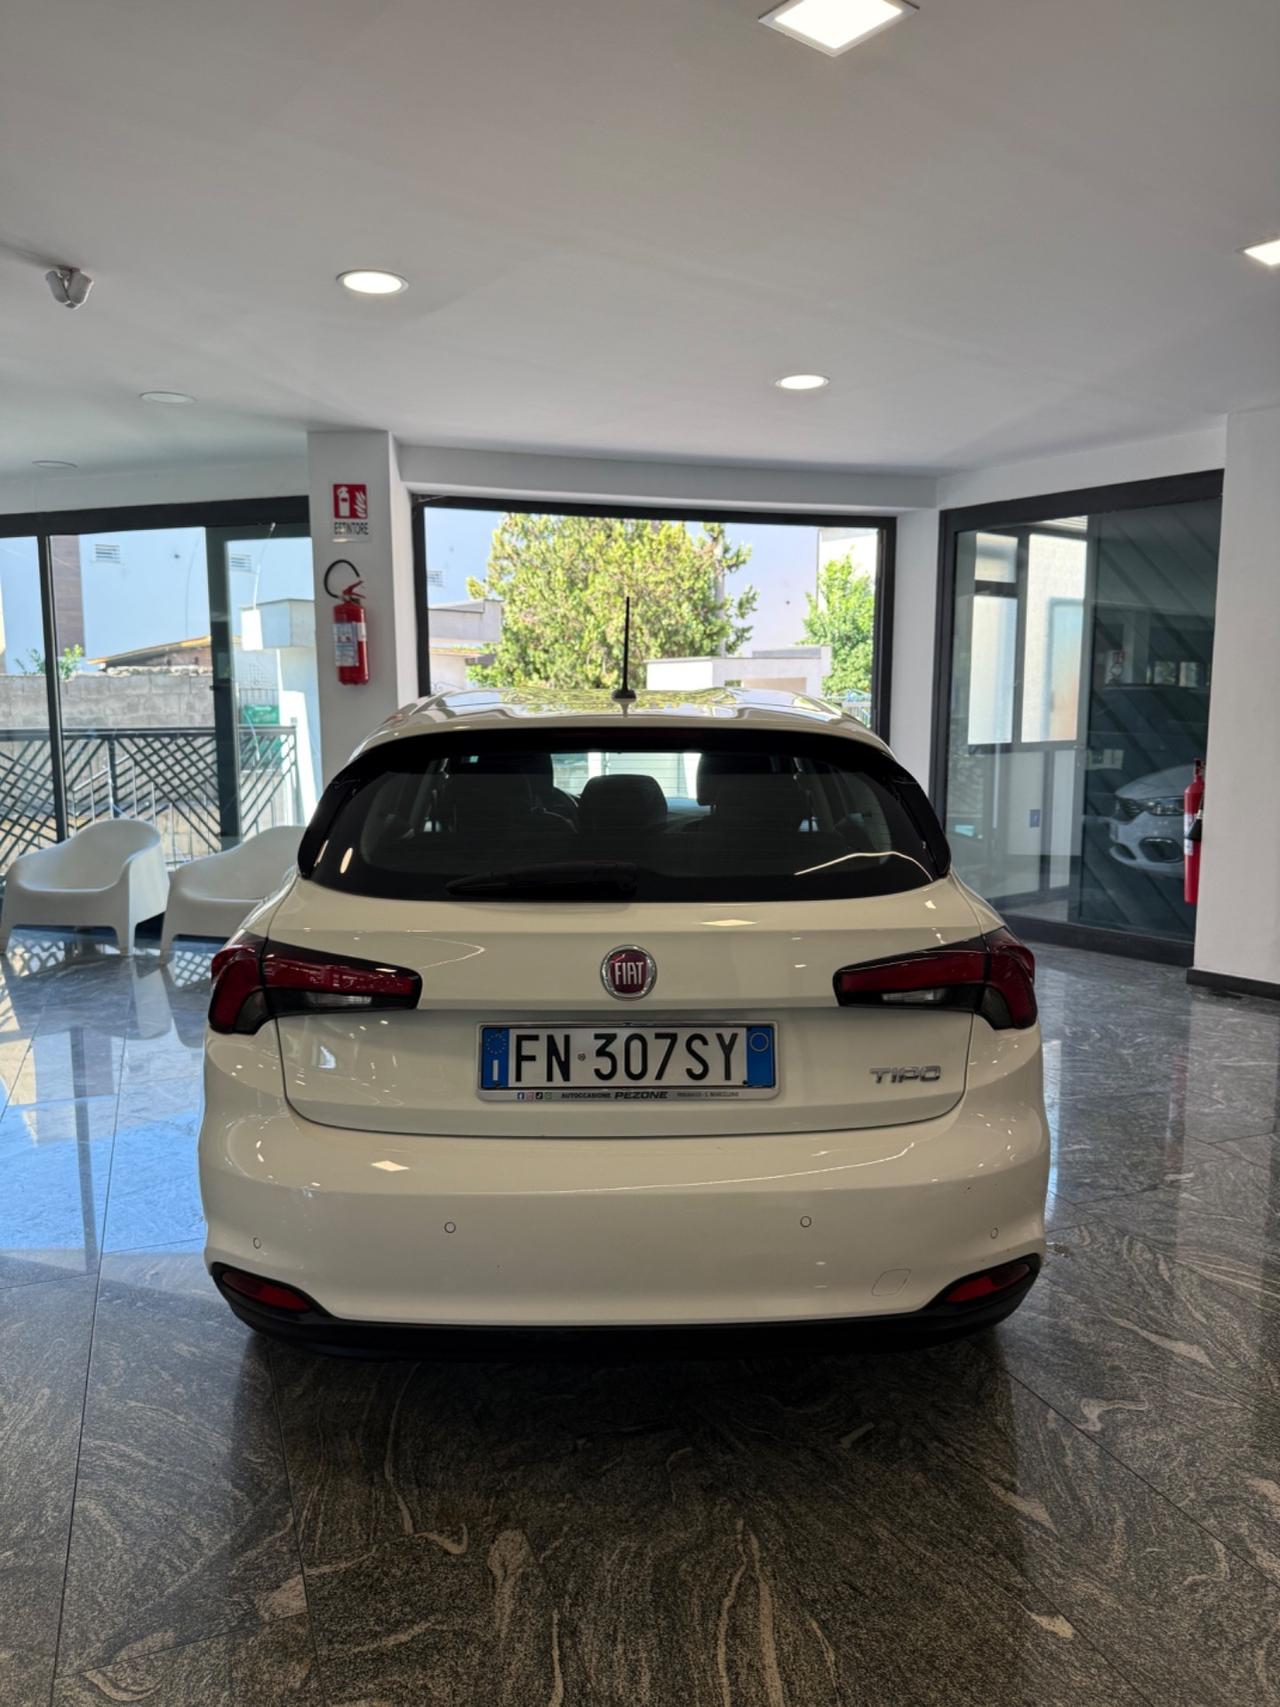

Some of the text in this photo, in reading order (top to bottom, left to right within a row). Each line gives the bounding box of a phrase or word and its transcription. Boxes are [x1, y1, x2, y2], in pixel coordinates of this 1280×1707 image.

[614, 962, 644, 985] FIAT
[515, 1034, 570, 1082] FN
[593, 1032, 739, 1081] 307SY
[869, 1065, 942, 1084] TIPO
[614, 1091, 669, 1099] PEZONE
